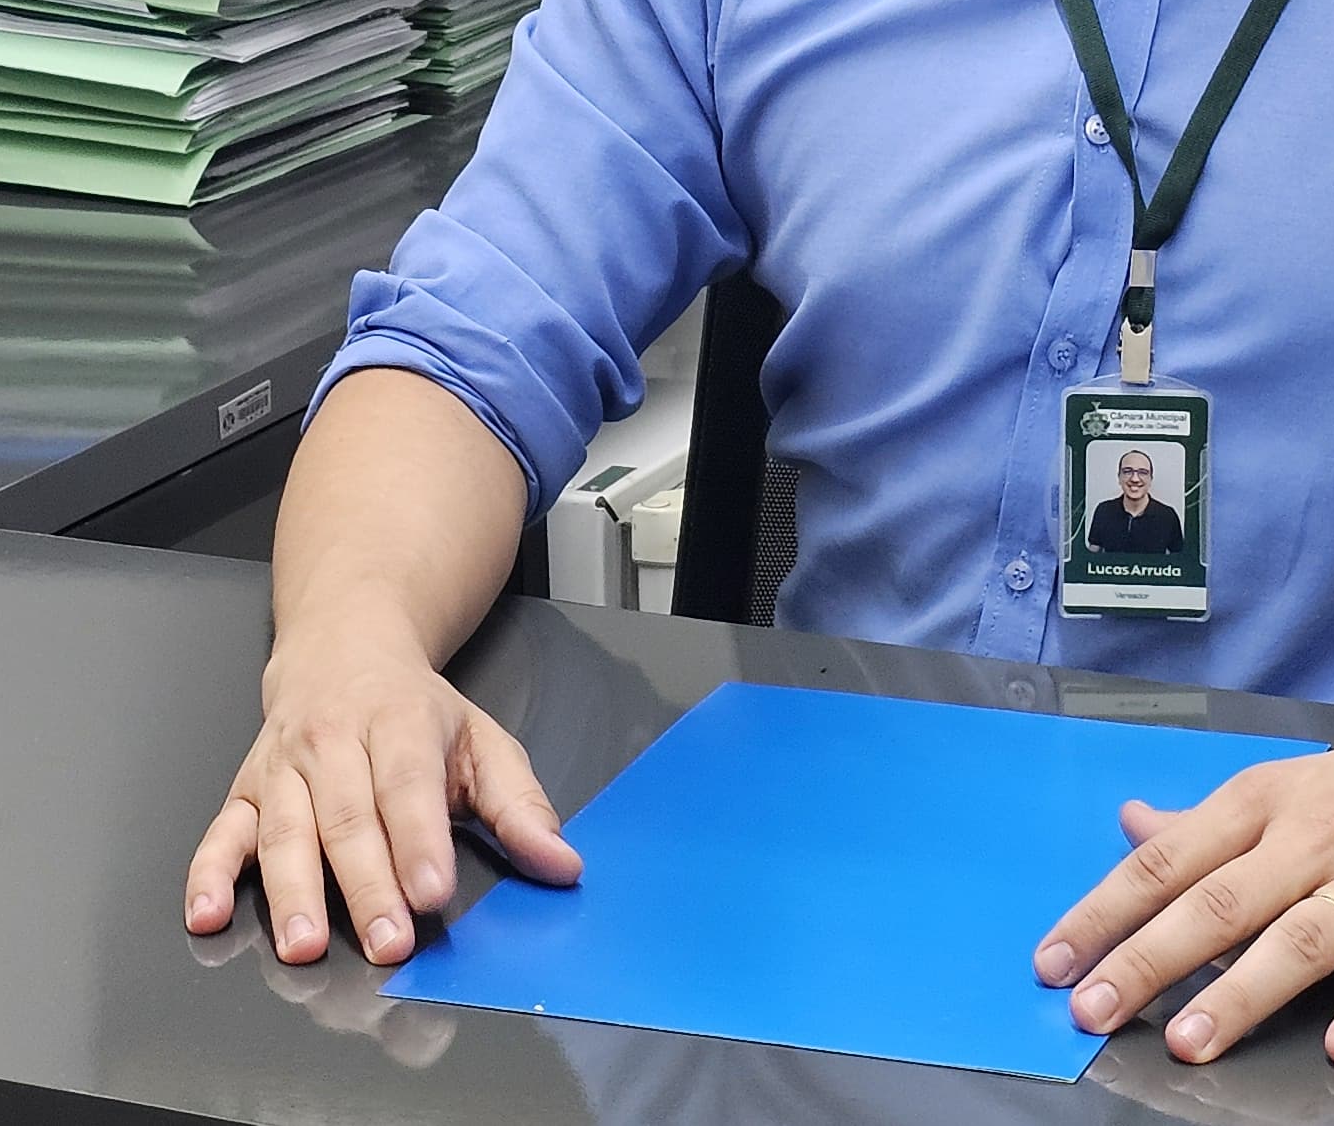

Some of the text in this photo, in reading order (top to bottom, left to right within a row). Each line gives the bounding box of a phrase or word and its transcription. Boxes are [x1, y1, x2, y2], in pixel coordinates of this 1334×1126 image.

[1109, 411, 1188, 423] Câmara Municipal
[1087, 561, 1183, 577] Lucas Arruda
